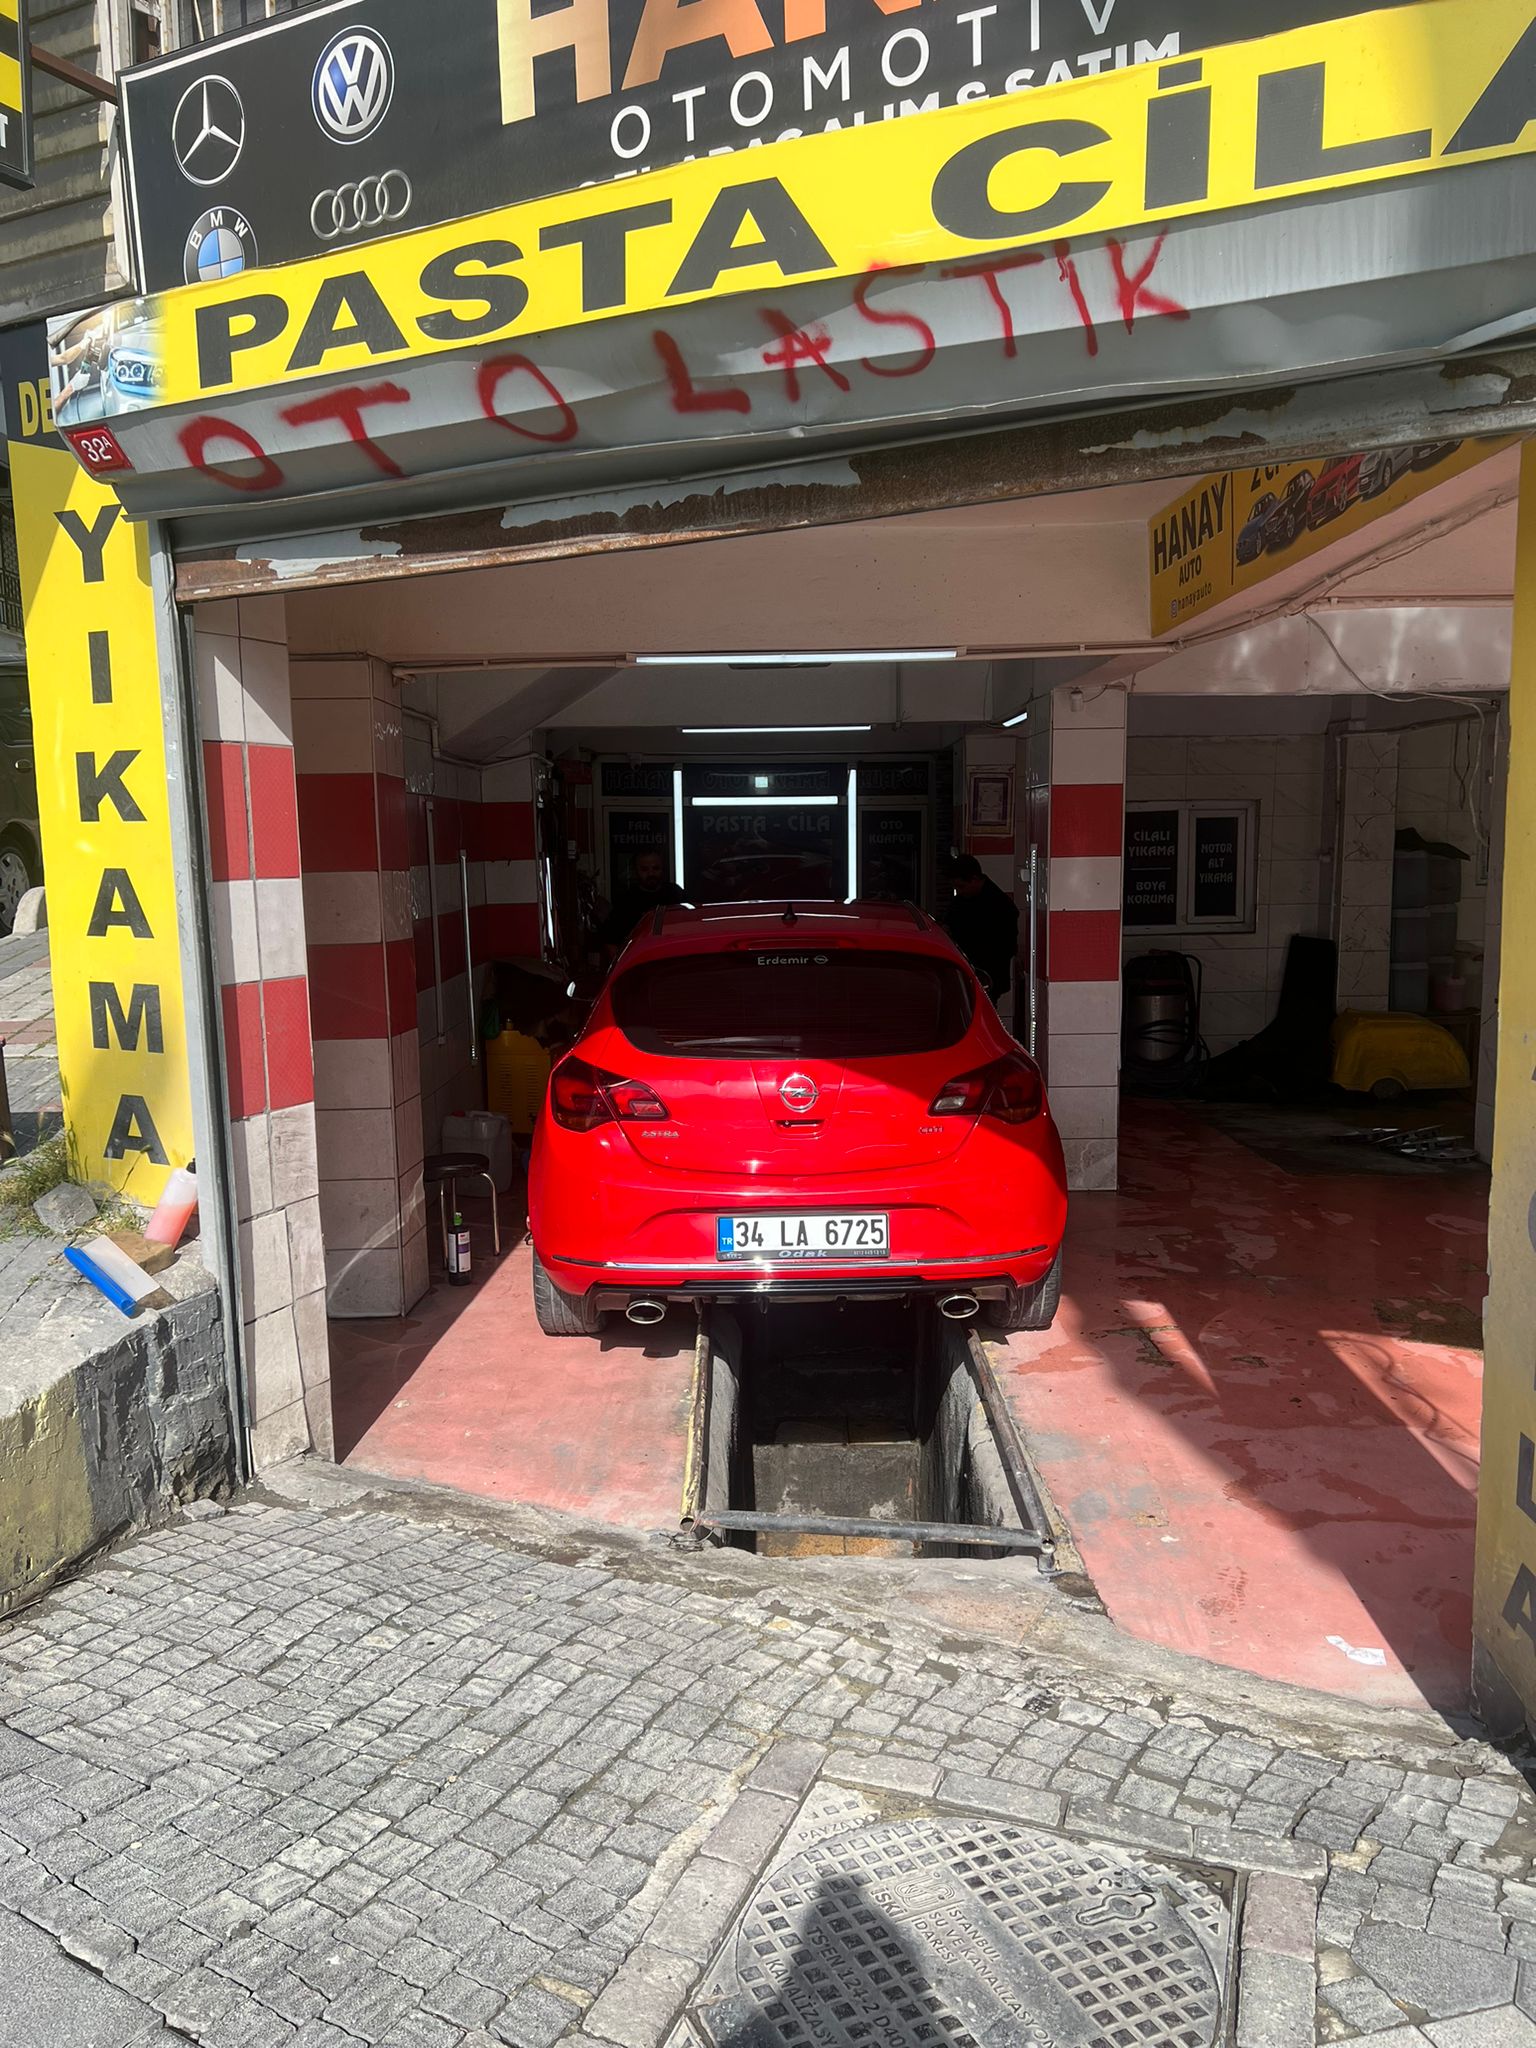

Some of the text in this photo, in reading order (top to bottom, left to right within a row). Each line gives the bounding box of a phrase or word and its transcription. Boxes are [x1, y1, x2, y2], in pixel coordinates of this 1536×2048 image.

[189, 209, 249, 250] BMW
[195, 176, 837, 390] PASTA
[1153, 473, 1228, 575] HANAY
[1178, 554, 1203, 587] AUTO
[702, 815, 767, 832] PASTA
[787, 811, 831, 832] CİLA
[880, 819, 904, 831] OTO
[1128, 844, 1175, 857] YIKAMA
[1200, 842, 1233, 854] MOTOR
[1207, 858, 1225, 869] ALT
[1199, 871, 1233, 884] YIKAMA
[1135, 880, 1167, 892] BOYA
[1127, 894, 1175, 905] KORUMA
[735, 1218, 884, 1247] 34 LA 6725
[721, 1236, 733, 1246] TR
[946, 1928, 964, 1948] VE
